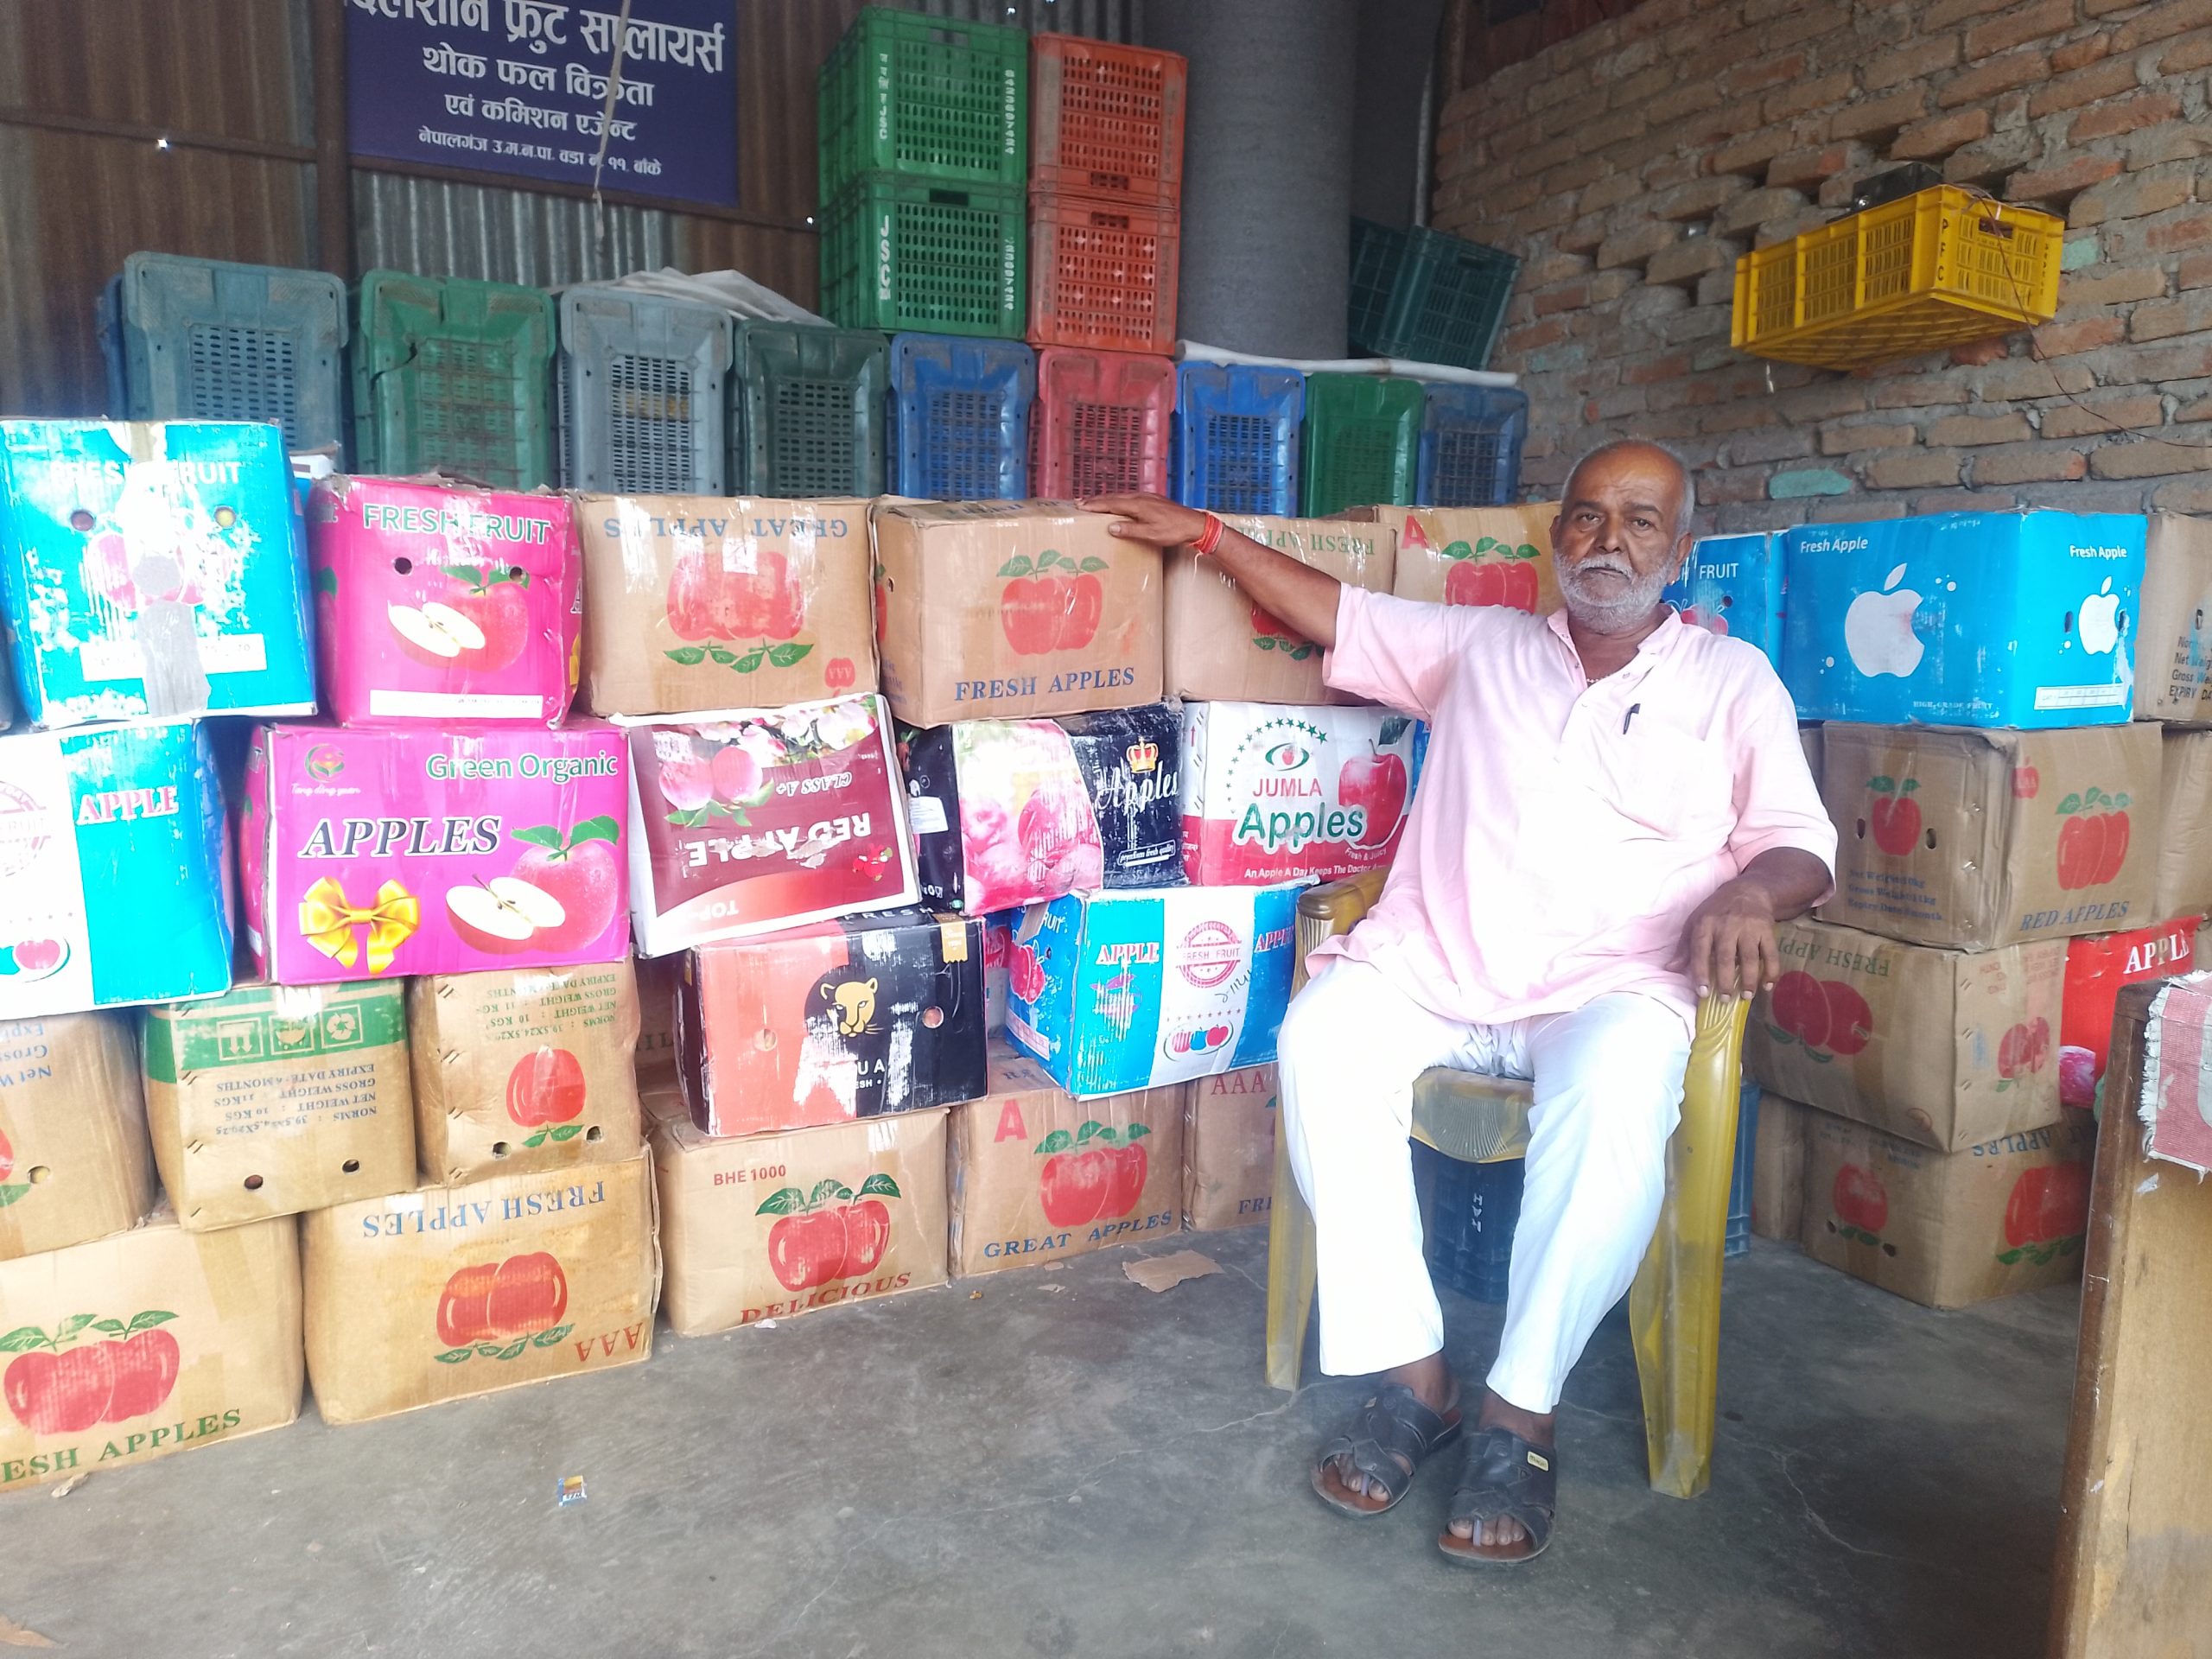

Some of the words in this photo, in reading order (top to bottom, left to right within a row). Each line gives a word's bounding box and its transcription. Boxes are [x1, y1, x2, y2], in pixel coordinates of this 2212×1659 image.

[423, 42, 487, 78] थोक
[496, 59, 556, 92] फल
[444, 93, 474, 117] एवं
[481, 97, 568, 130] कमिशन
[558, 149, 584, 164] वडा
[50, 461, 126, 484] FRES
[363, 505, 459, 534] FRESH
[469, 513, 550, 544] FRUIT
[604, 518, 726, 537] APPLS
[1402, 514, 1430, 550] A
[1310, 533, 1376, 556] FRESH
[1800, 539, 1830, 554] Fresh
[1833, 537, 1868, 556] Apple
[2069, 544, 2096, 559] Fresh
[2098, 545, 2127, 561] Apple
[1699, 563, 1739, 580] FRUIT
[954, 677, 1037, 702] FRESH
[1049, 666, 1135, 693] APPLES
[2172, 669, 2194, 682] Gross
[426, 753, 512, 779] Green
[519, 751, 618, 784] Organic
[802, 772, 852, 792] CLASS
[1095, 760, 1178, 815] Apples
[1253, 778, 1322, 798] JUMLA
[76, 785, 178, 825] APPLE
[1237, 802, 1364, 849] Apples
[298, 815, 502, 859] APPLES
[1344, 848, 1362, 861] Fresh
[1244, 868, 1258, 878] An
[1259, 868, 1282, 880] Apple
[1285, 868, 1292, 876] A
[1334, 865, 1346, 874] The
[1042, 912, 1062, 934] RUIT
[2019, 909, 2059, 931] RED
[2063, 900, 2130, 925] APPLES
[1096, 942, 1160, 965] APPLE
[1826, 948, 1891, 976] FRESH
[580, 974, 616, 988] EXPIRY
[539, 993, 582, 1007] WEIGHT
[584, 988, 616, 999] GROSS
[490, 1015, 512, 1027] KGS
[519, 1014, 529, 1023] 10
[553, 1004, 595, 1019] WEIGHT
[583, 1014, 616, 1027] NORMS
[20, 1065, 52, 1080] Net
[326, 1064, 375, 1079] EXPIRY
[216, 1078, 272, 1093] MONTHS
[279, 1085, 332, 1099] WEIGHT
[335, 1077, 376, 1090] GROSS
[1211, 1071, 1267, 1095] AAA
[297, 1096, 349, 1112] WEIGHT
[352, 1091, 376, 1104] NET
[225, 1110, 251, 1122] KGS
[333, 1106, 378, 1122] NORMS
[994, 1099, 1028, 1143] A
[714, 1171, 746, 1185] BHE
[751, 1165, 787, 1181] 1000
[503, 1181, 606, 1220] FRESH
[363, 1200, 491, 1238] APPLES
[983, 1233, 1071, 1258] GREAT
[1089, 1211, 1173, 1243] APPLES
[741, 1272, 912, 1324] DELICIOUS
[575, 1323, 644, 1362] AAA
[99, 1408, 241, 1461] APPLES
